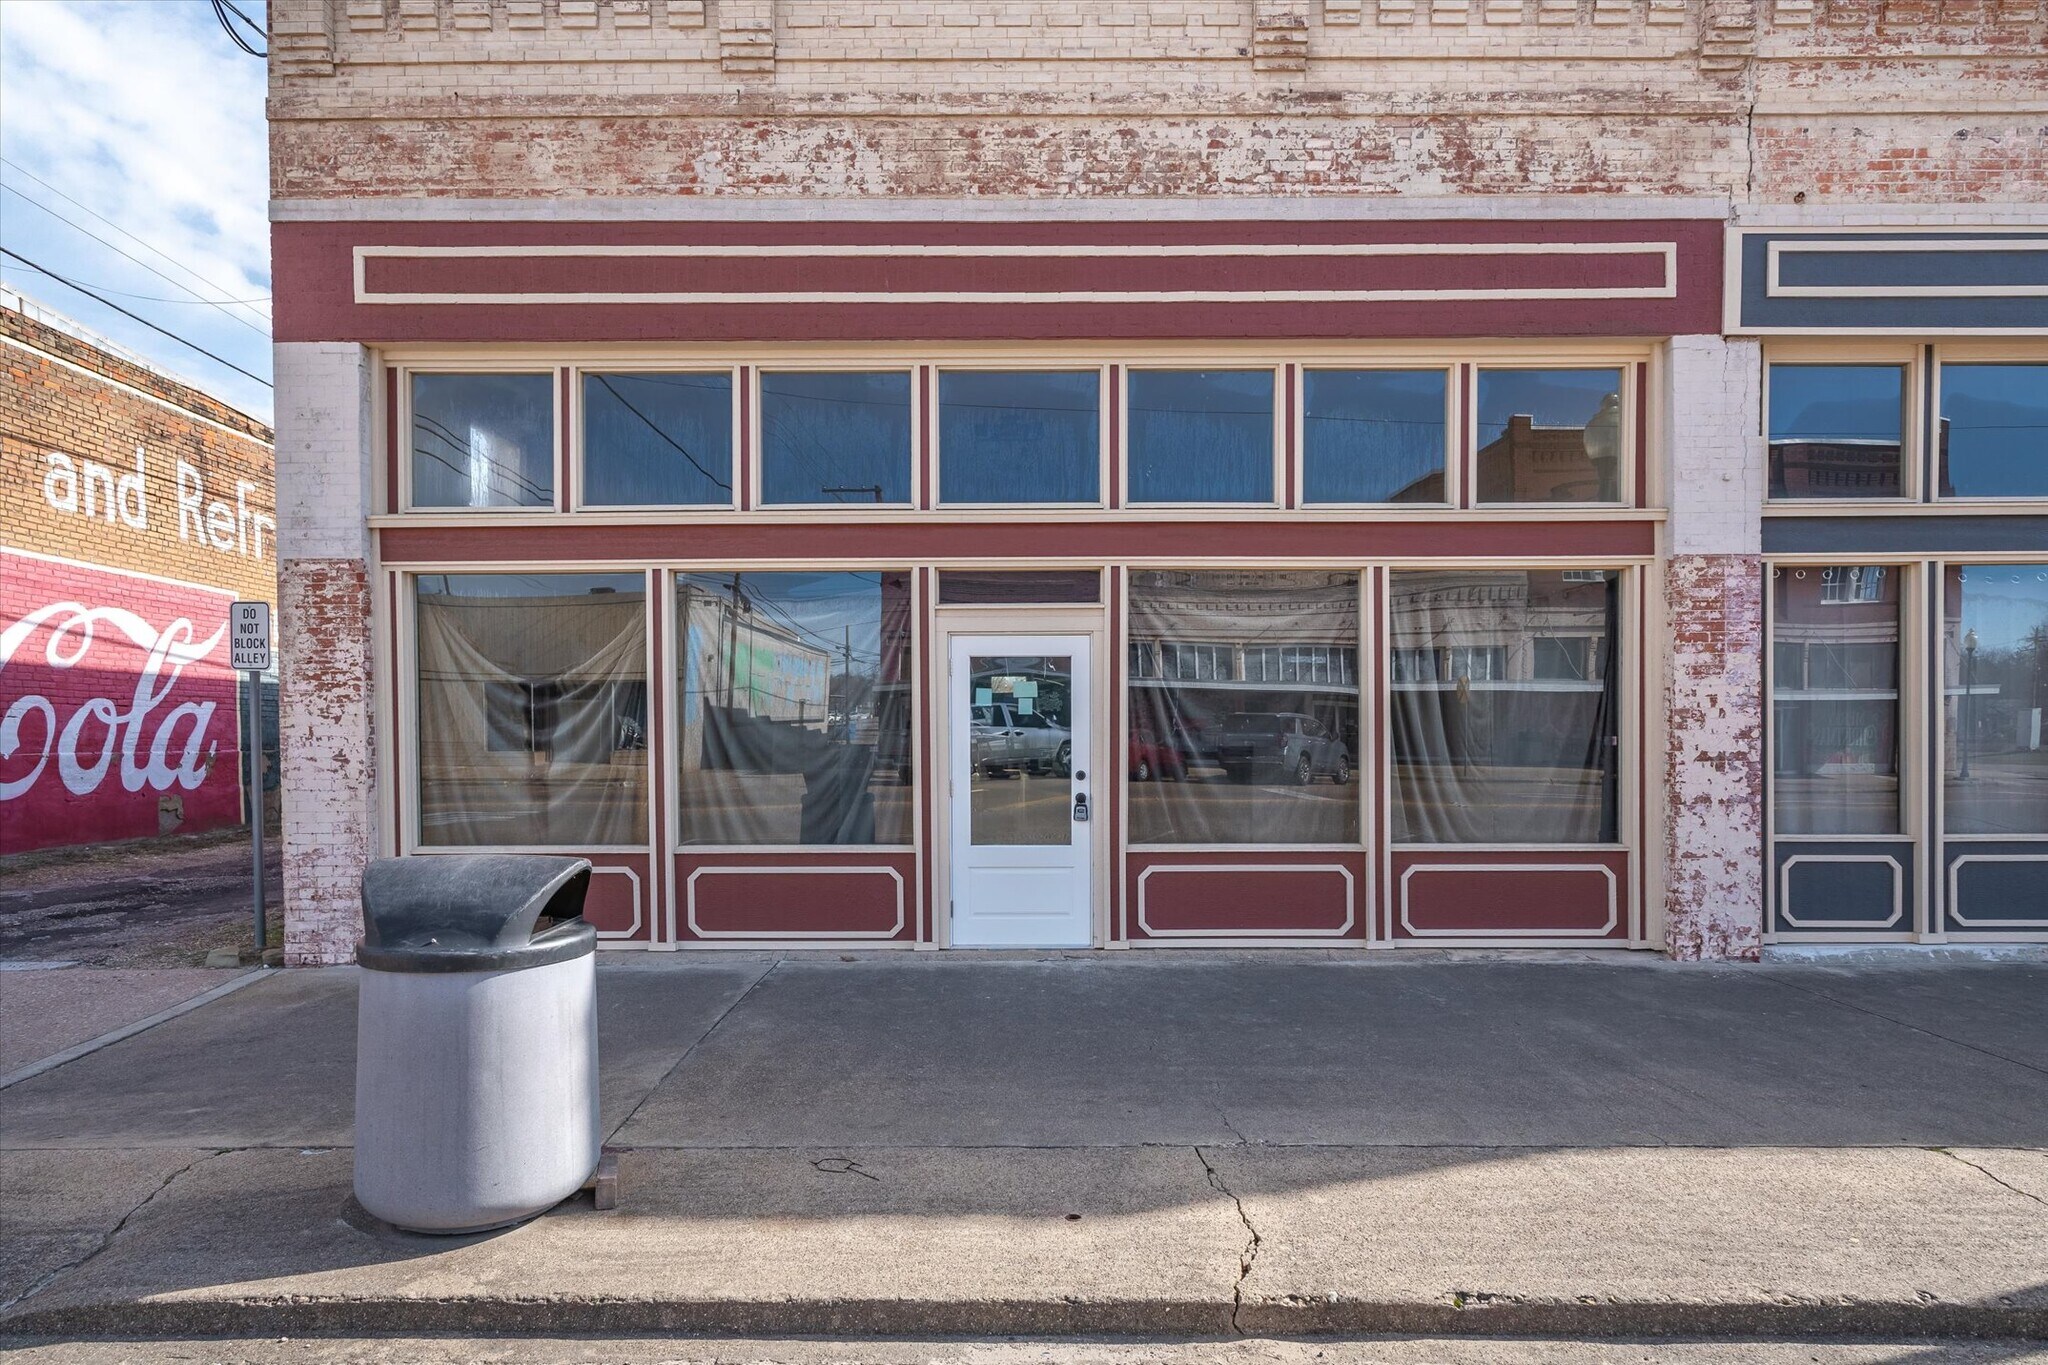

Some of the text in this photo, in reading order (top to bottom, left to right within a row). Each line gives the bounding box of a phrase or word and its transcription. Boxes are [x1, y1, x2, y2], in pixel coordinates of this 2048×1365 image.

[43, 446, 148, 530] and
[243, 608, 257, 619] DO
[240, 623, 260, 634] NOT
[234, 638, 266, 649] BLOCK
[234, 653, 266, 664] ALLEY
